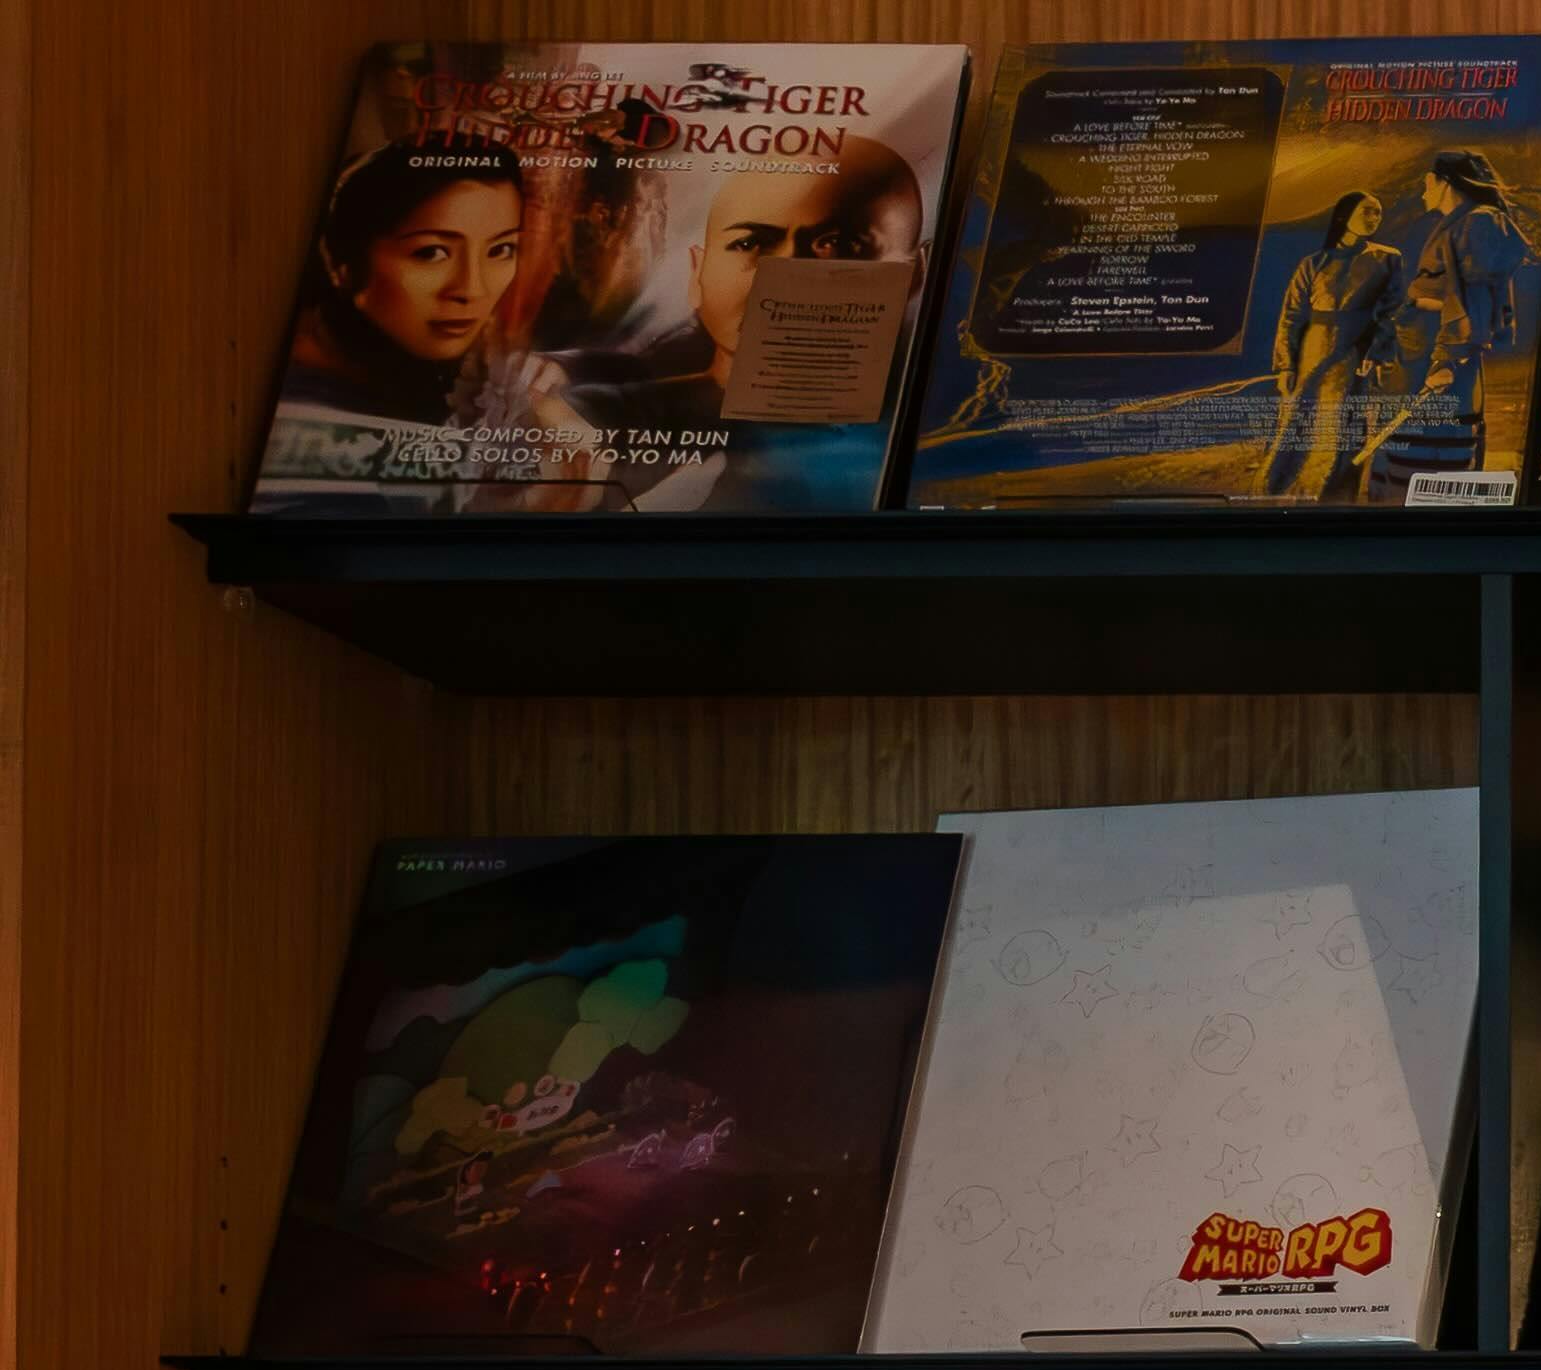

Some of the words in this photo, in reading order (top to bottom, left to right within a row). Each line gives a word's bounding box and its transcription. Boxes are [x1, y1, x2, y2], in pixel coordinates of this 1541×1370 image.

[731, 75, 870, 118] TIGER
[635, 111, 846, 156] DRAGON
[1203, 1222, 1284, 1252] SUPER
[1286, 1212, 1380, 1271] RPG
[1193, 1246, 1280, 1276] MARIO
[1169, 1309, 1198, 1318] SUPER
[1202, 1309, 1232, 1318] MARIO
[1236, 1309, 1253, 1317] RPG
[1256, 1307, 1301, 1317] ORIGINAL
[1305, 1306, 1337, 1315] SOUND
[1340, 1306, 1367, 1314] VINYL
[1370, 1304, 1390, 1313] BOX
